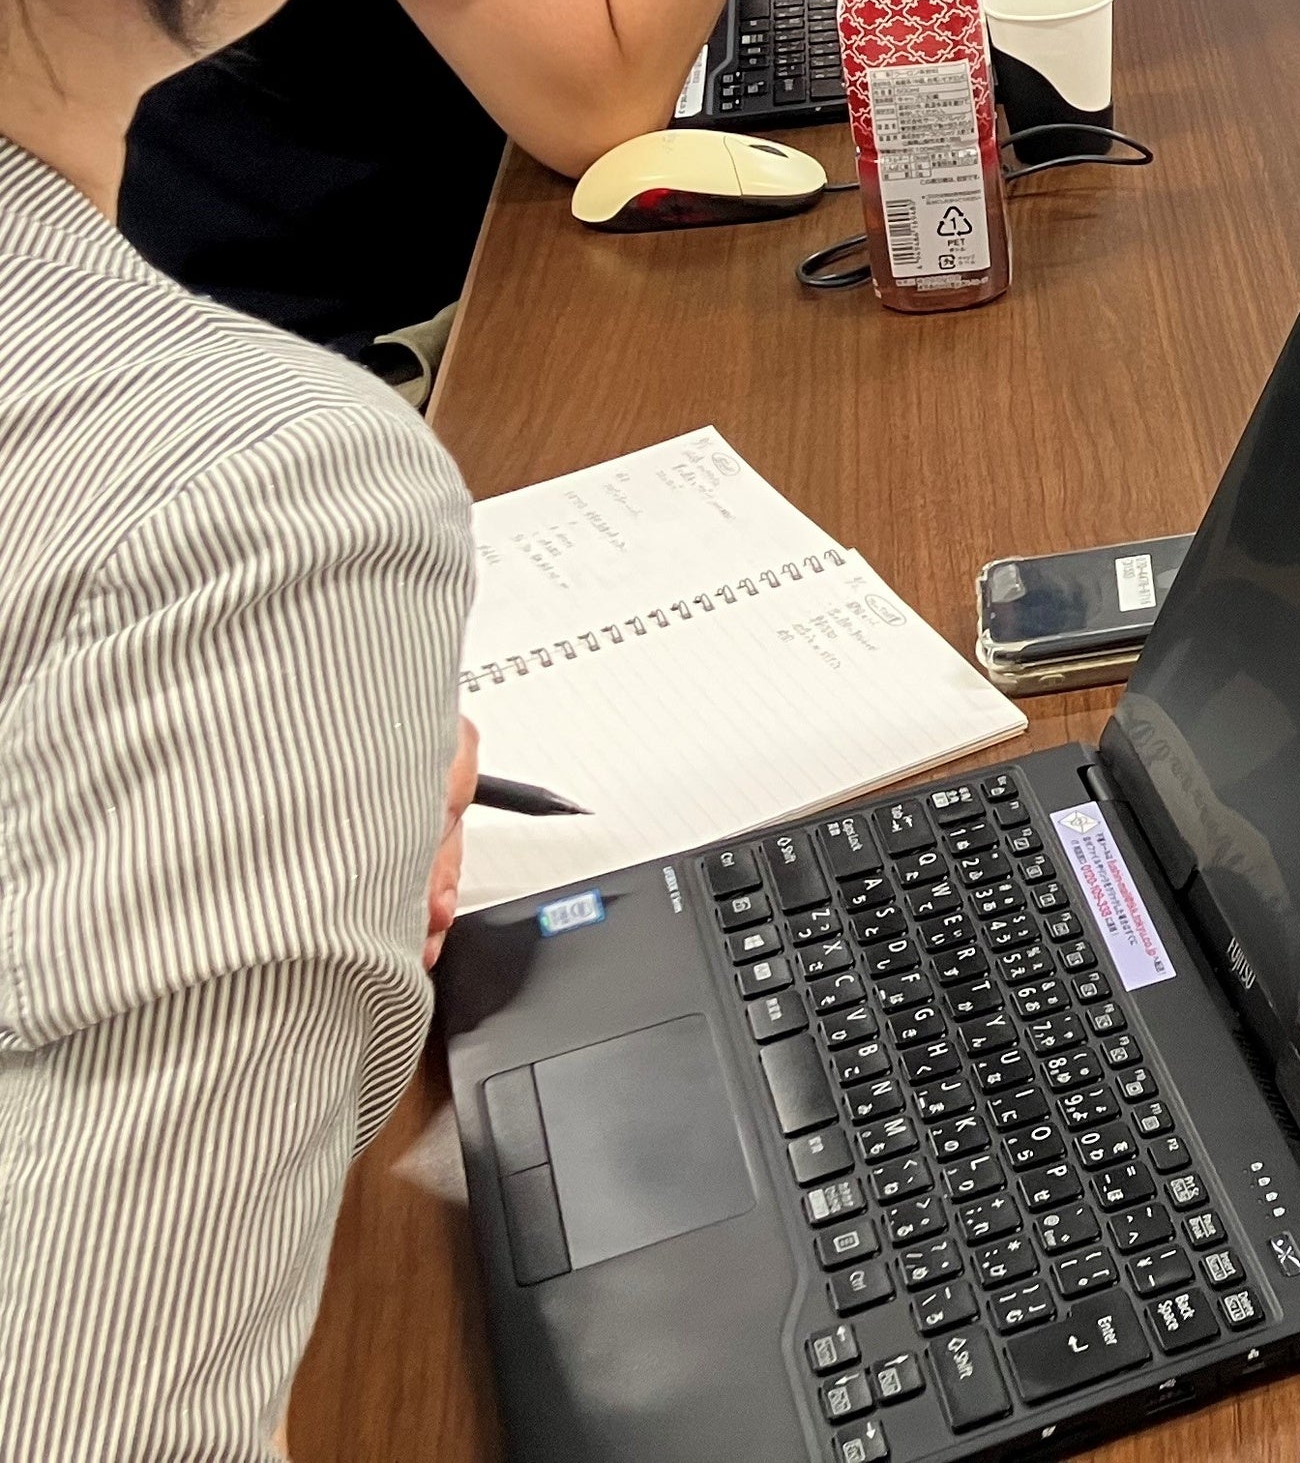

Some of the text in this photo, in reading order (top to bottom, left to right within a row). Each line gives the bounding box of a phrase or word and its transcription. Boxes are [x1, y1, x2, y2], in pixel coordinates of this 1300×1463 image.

[947, 238, 965, 247] PET
[919, 853, 937, 866] Q
[962, 858, 980, 868] 2
[864, 879, 883, 891] A
[932, 882, 952, 897] W
[976, 889, 993, 899] 3
[812, 909, 831, 921] Z
[876, 908, 895, 918] S
[944, 915, 963, 926] E
[991, 922, 1007, 931] 4
[823, 941, 843, 955] X
[889, 940, 908, 953] D
[957, 948, 976, 961] R
[1003, 954, 1022, 964] 5
[1226, 936, 1257, 990] FUJITSU
[836, 975, 855, 988] C
[901, 974, 921, 983] F
[972, 981, 991, 991] T
[1018, 988, 1037, 998] 6
[847, 1008, 868, 1021] V
[915, 1009, 935, 1021] G
[987, 1015, 1006, 1027] Y
[1033, 1021, 1052, 1030] 7
[859, 1044, 878, 1057] B
[928, 1043, 949, 1057] H
[1001, 1051, 1021, 1064] U
[1049, 1058, 1068, 1069] 8
[872, 1081, 893, 1096] N
[941, 1083, 962, 1091] J
[1065, 1095, 1084, 1106] 9
[884, 1119, 907, 1137] M
[956, 1117, 977, 1132] K
[1031, 1127, 1052, 1141] O
[1081, 1133, 1101, 1145] 0
[971, 1156, 990, 1171] L
[1047, 1165, 1068, 1177] P
[1175, 1294, 1195, 1321] Back
[1158, 1300, 1179, 1331] Space
[1098, 1316, 1118, 1345] Enter
